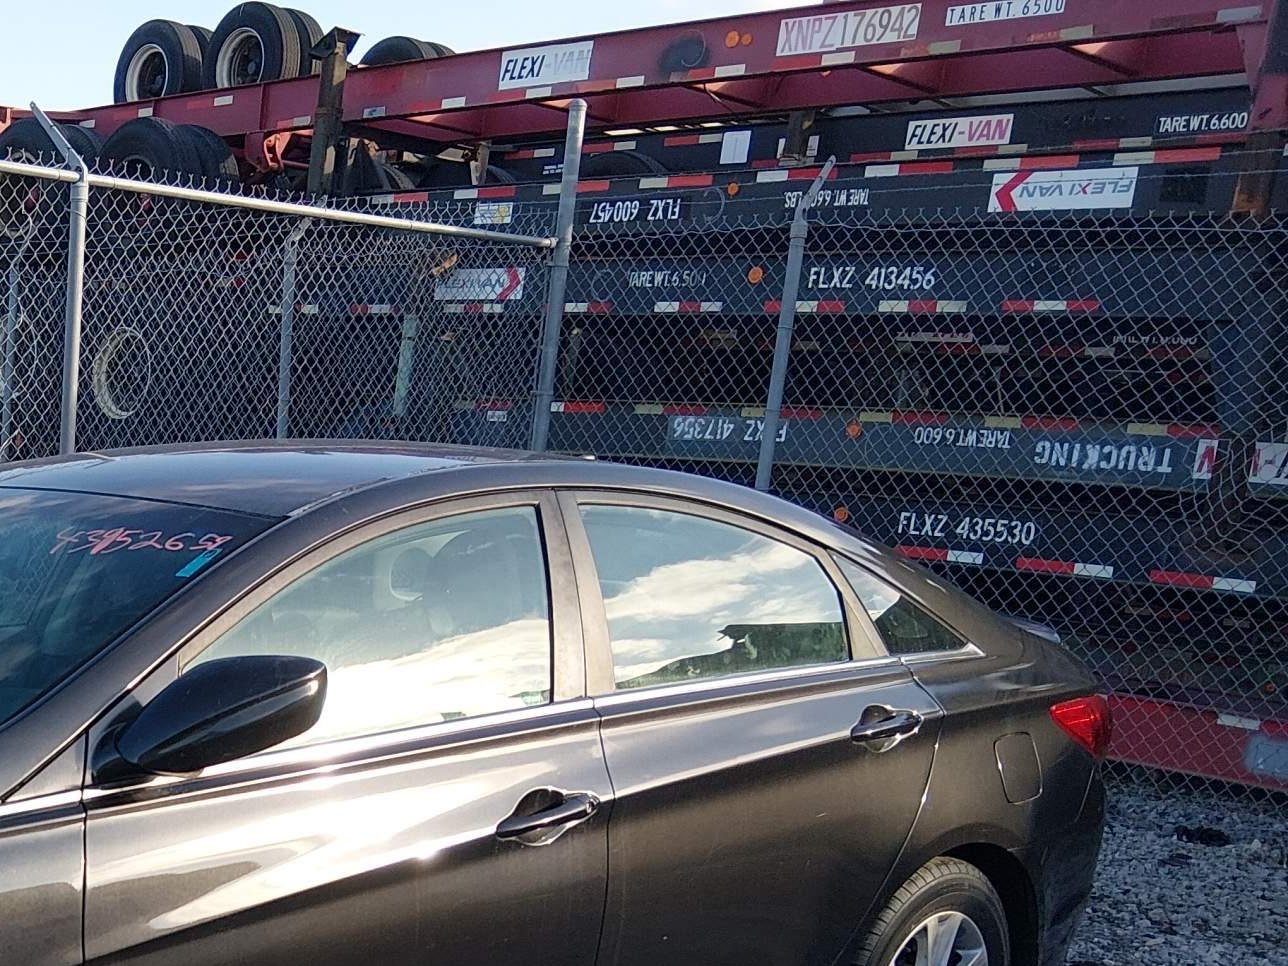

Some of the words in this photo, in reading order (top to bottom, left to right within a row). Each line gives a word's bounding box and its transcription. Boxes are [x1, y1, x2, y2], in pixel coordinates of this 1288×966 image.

[949, 5, 987, 24] TARE
[993, 2, 1016, 18] WT.
[1022, 0, 1064, 15] 6500
[907, 118, 1010, 145] FLEXI-VAN
[1019, 182, 1064, 198] VAN
[1069, 180, 1133, 195] FLEXI
[589, 200, 640, 223] 600457
[647, 199, 681, 221] FLXZ
[808, 266, 856, 289] FLXZ
[865, 266, 936, 290] 413456
[673, 417, 735, 441] 417356
[743, 419, 789, 442] FXZ
[1034, 440, 1173, 473] TRUCKING
[897, 511, 948, 537] FLXZ
[956, 516, 1036, 545] 435530
